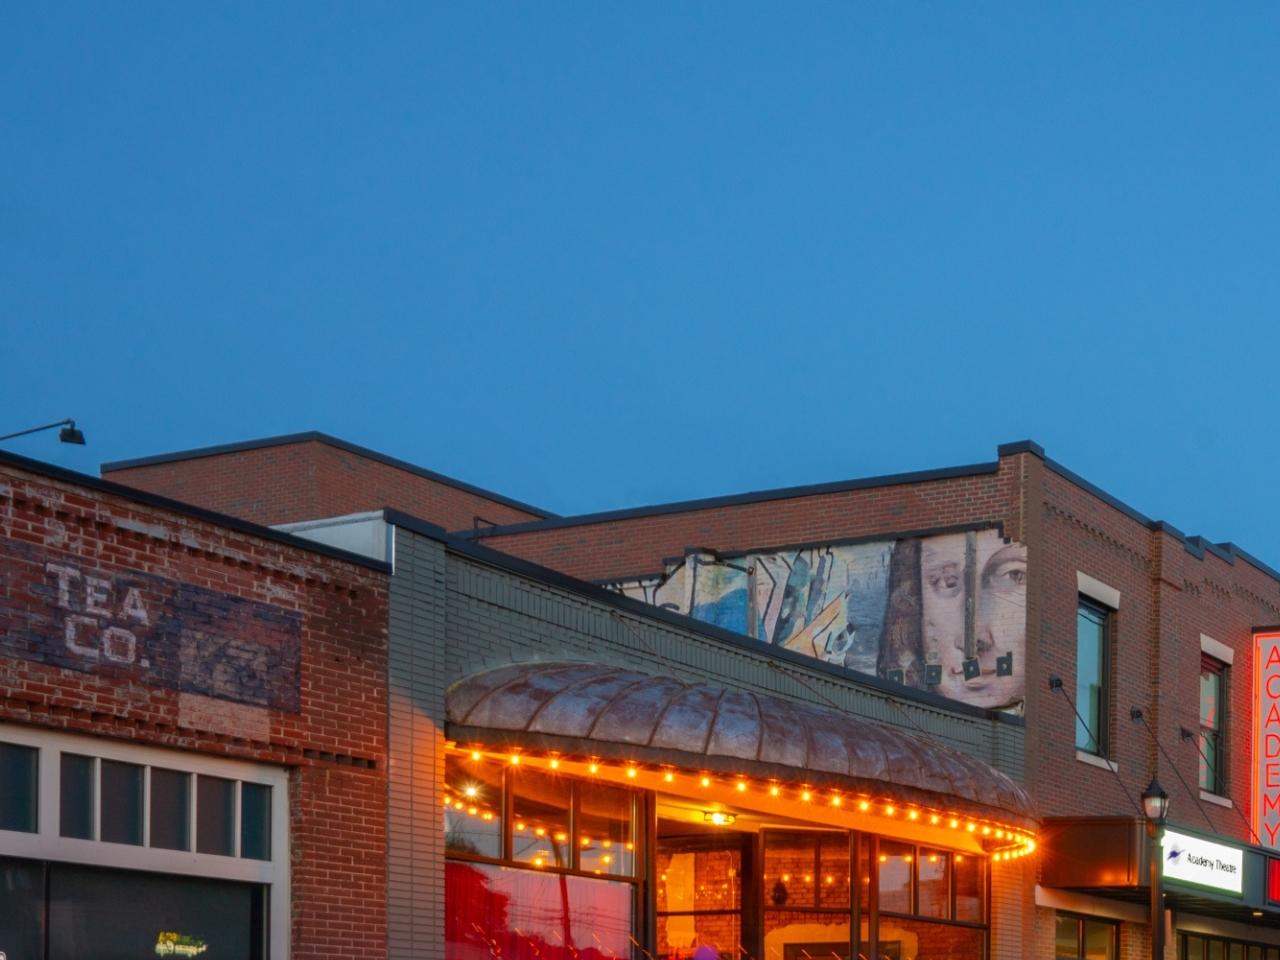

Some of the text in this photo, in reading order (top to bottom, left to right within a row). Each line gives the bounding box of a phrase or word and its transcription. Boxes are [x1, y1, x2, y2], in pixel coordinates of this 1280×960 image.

[46, 562, 150, 625] TEA
[64, 614, 150, 668] CO.
[1187, 853, 1237, 874] Academy Theatre
